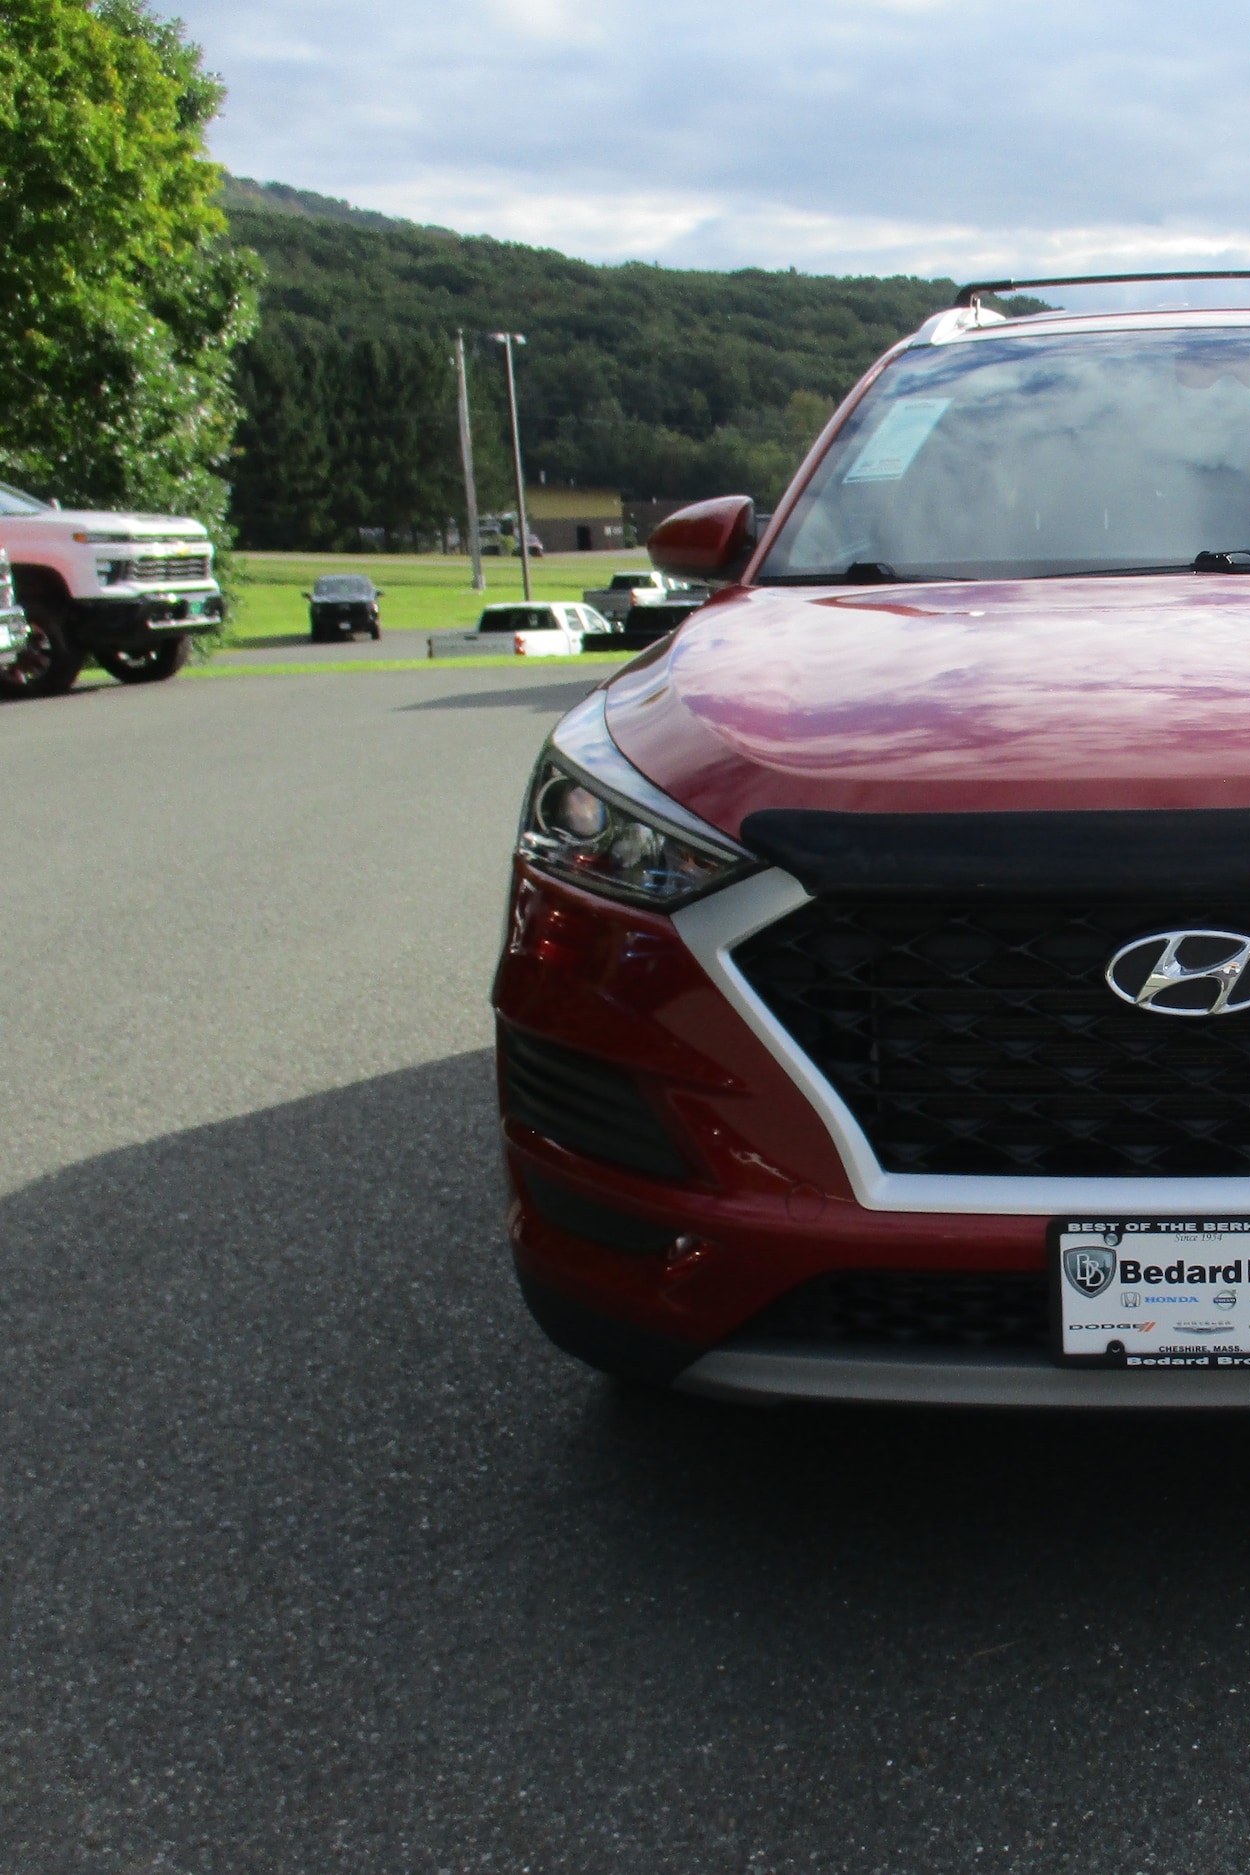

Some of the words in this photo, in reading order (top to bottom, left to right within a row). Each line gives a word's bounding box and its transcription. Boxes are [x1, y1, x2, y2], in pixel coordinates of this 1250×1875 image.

[1068, 1222, 1119, 1232] BEST
[1125, 1222, 1151, 1231] OF
[1157, 1222, 1197, 1231] THE
[1119, 1259, 1242, 1284] Bedard
[1069, 1322, 1145, 1330] DODGE
[1159, 1345, 1210, 1353] CHESHIRE,
[1126, 1356, 1209, 1366] Bedard
